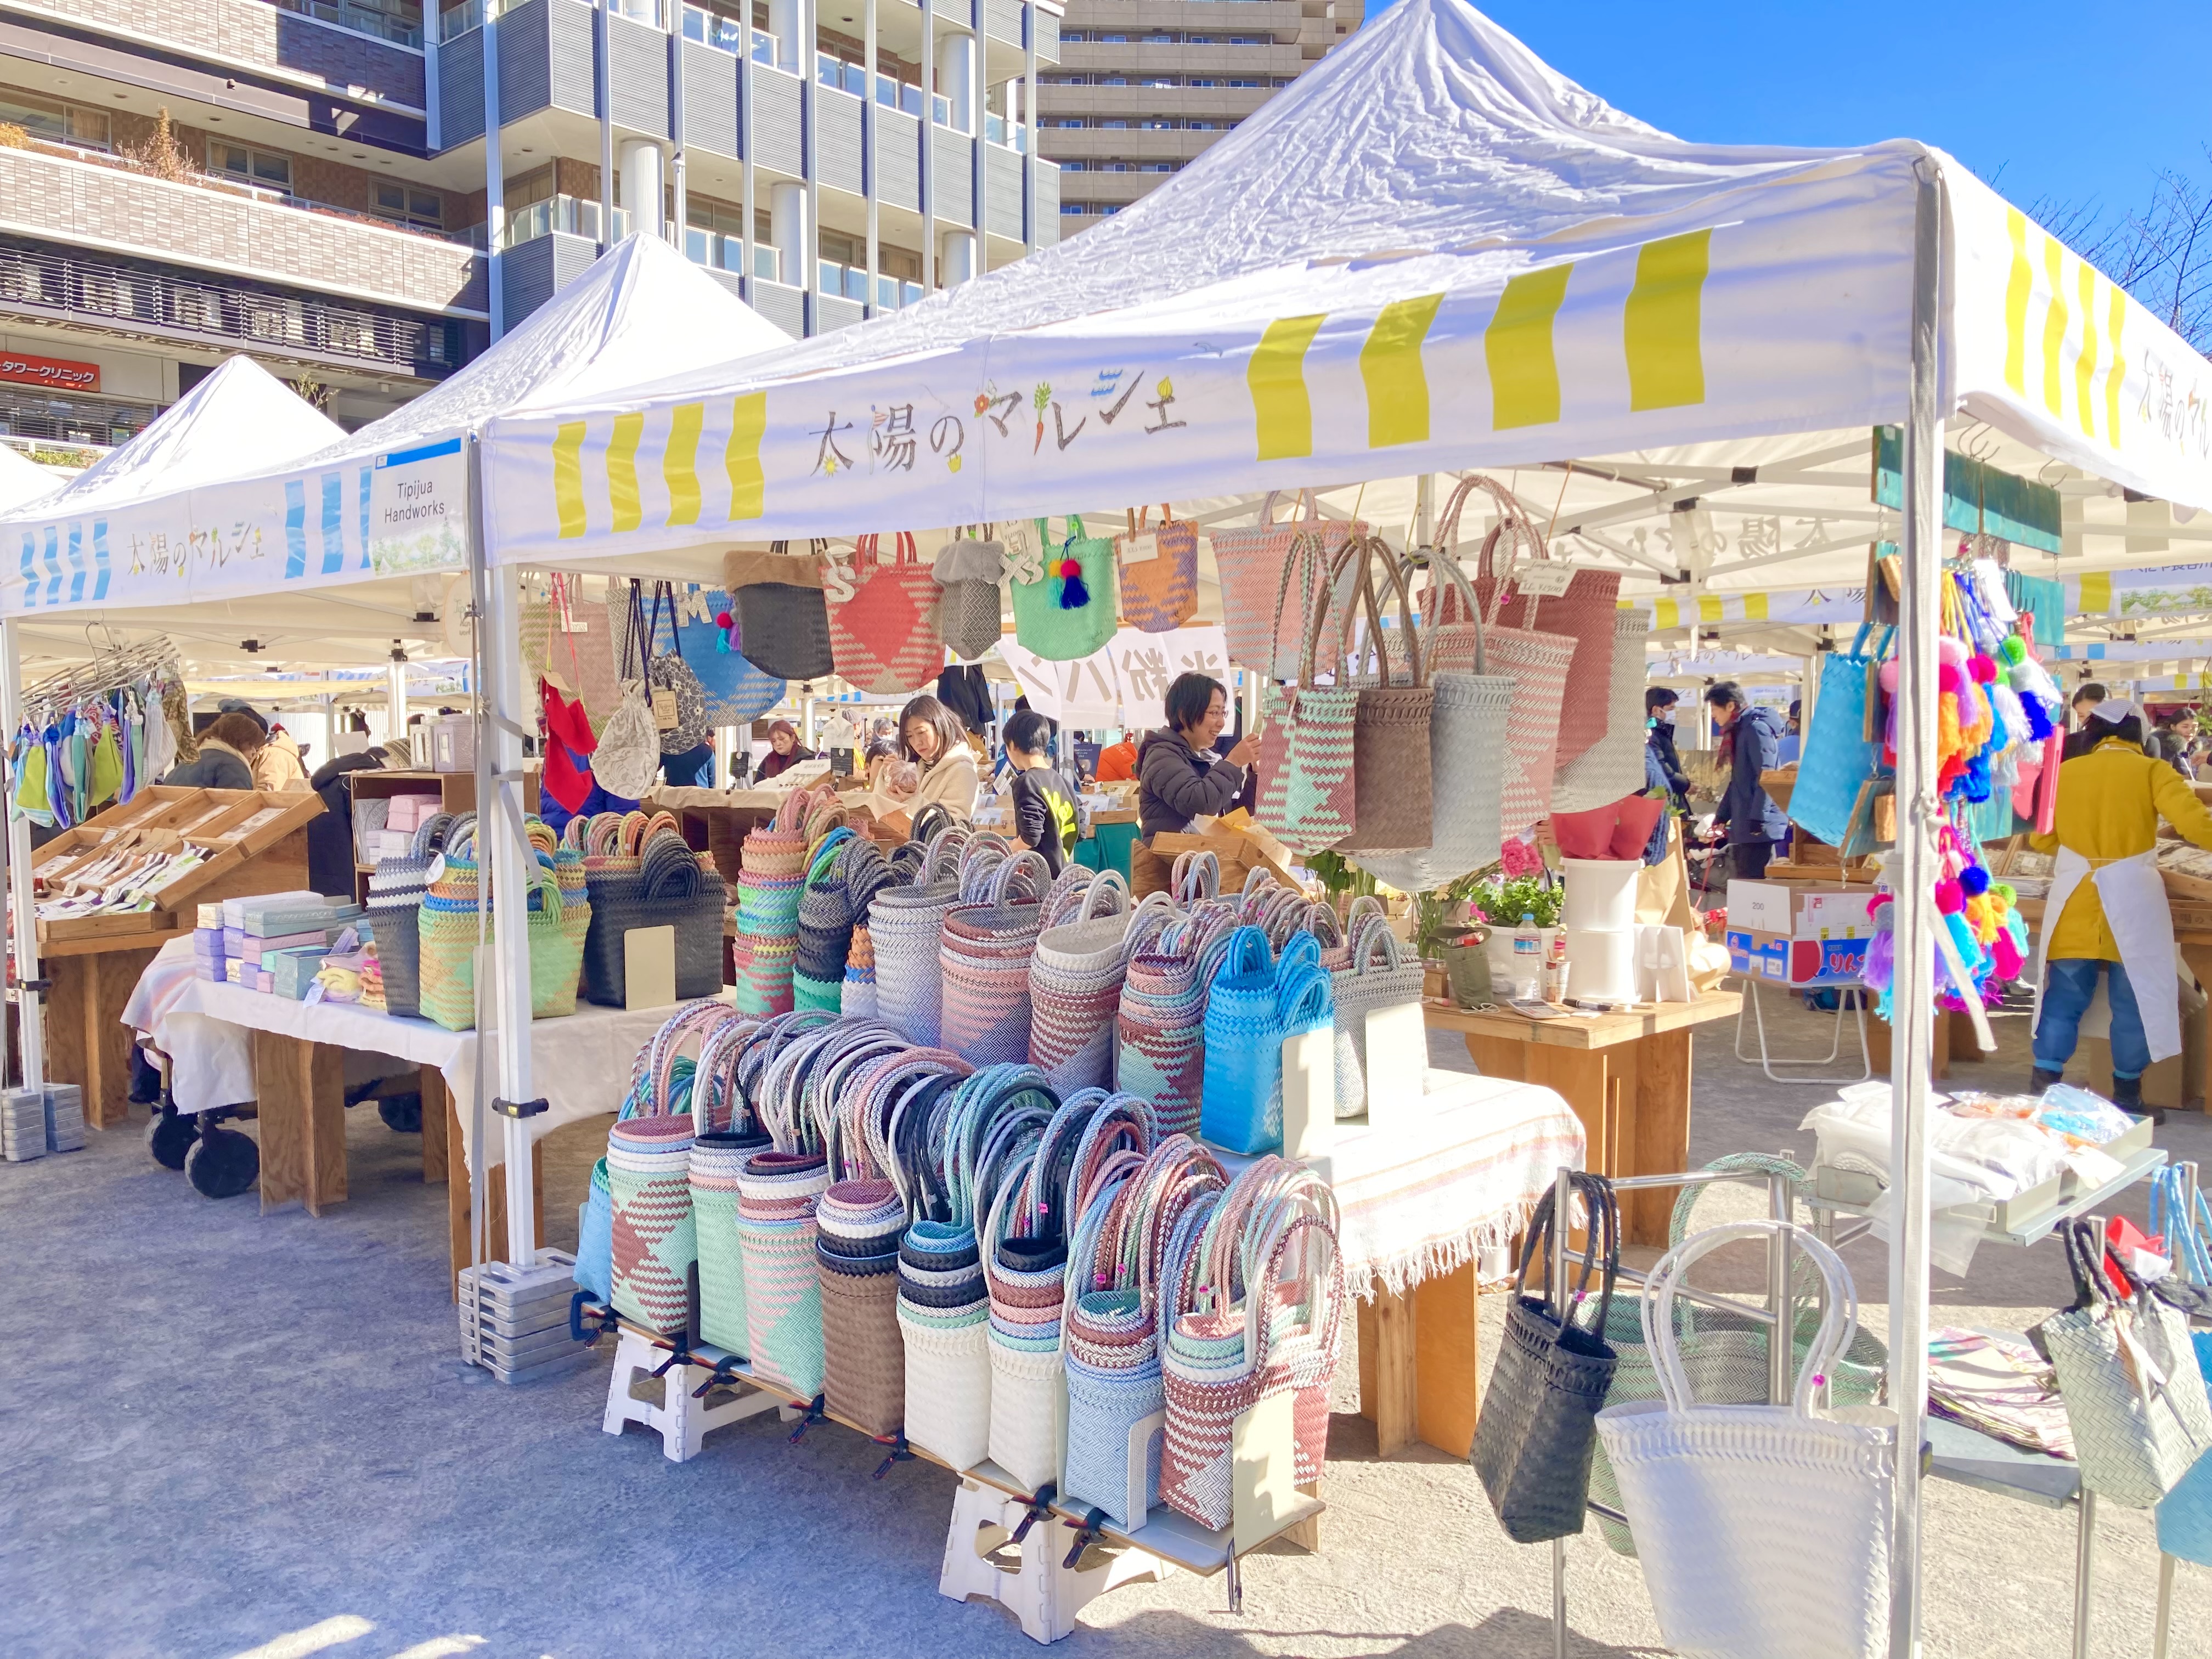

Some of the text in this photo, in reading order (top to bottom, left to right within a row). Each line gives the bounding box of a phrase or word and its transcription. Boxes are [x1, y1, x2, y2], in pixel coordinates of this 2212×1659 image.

[0, 360, 95, 383] タワークリニック
[808, 369, 1187, 477] 太陽のマルシェ
[397, 479, 432, 501] Tipijua
[385, 500, 444, 523] Handworks
[127, 521, 264, 577] 太陽のマルシェ
[1752, 902, 1764, 910] 200
